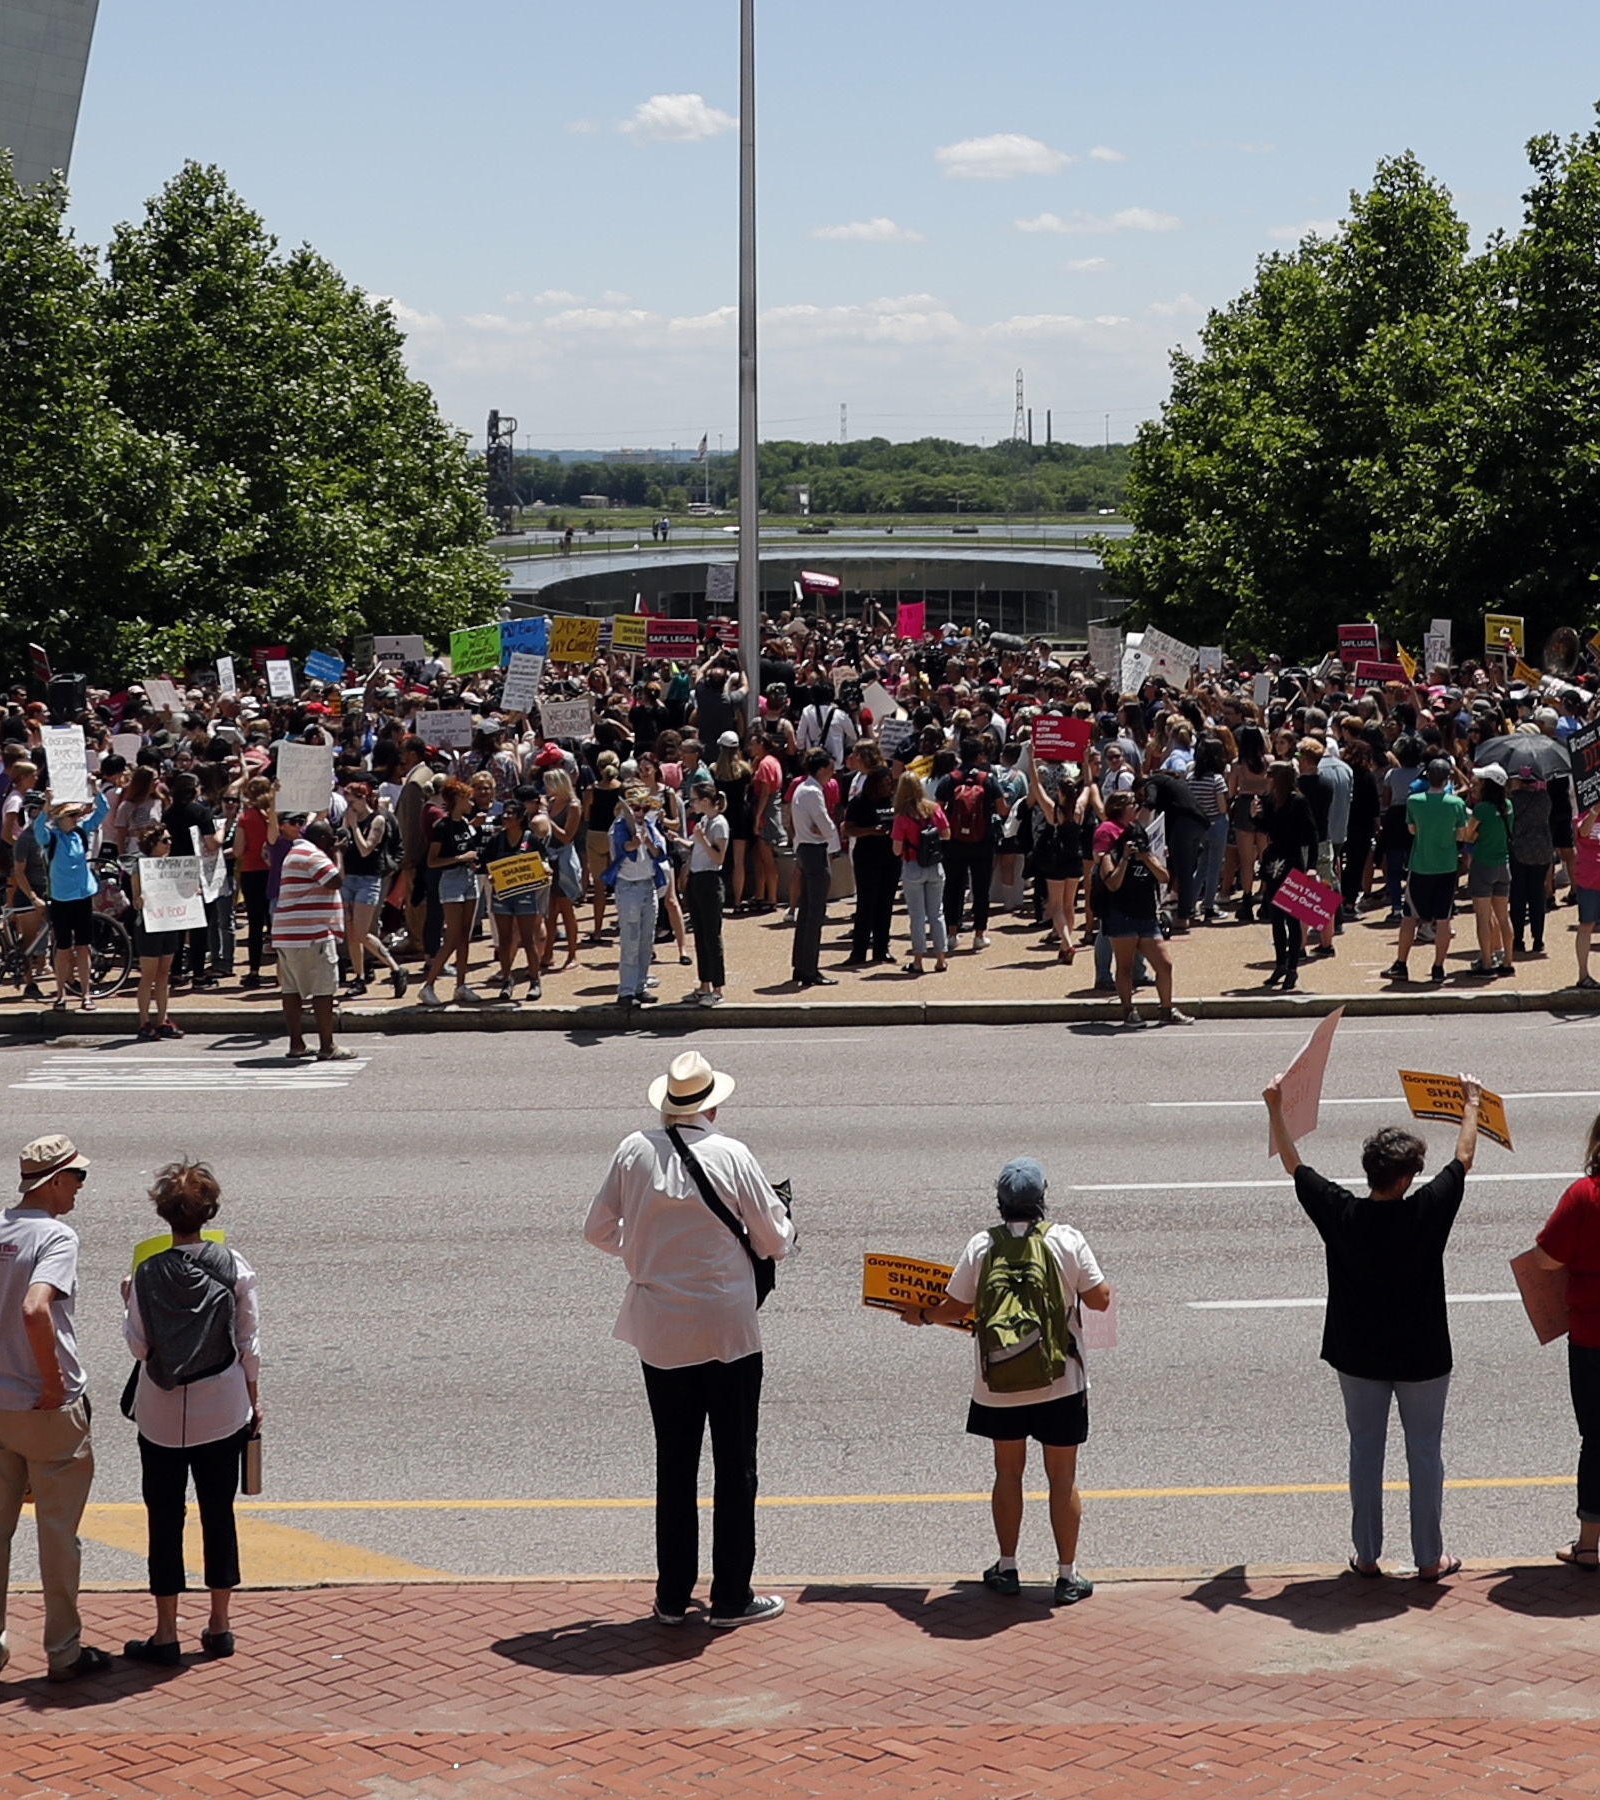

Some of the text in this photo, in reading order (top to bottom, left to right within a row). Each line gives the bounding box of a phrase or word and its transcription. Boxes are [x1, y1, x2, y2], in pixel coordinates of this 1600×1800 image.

[1365, 667, 1402, 677] PROTECT
[1035, 740, 1076, 748] PARENTHOOD
[1569, 730, 1597, 753] Women
[489, 860, 518, 872] Governor
[501, 864, 532, 878] SHAME
[505, 873, 536, 886] on YOU
[1279, 884, 1300, 901] Away
[1298, 896, 1314, 909] Our
[1284, 877, 1322, 903] Don't Take
[1403, 1075, 1461, 1088] Governo
[1426, 1087, 1463, 1101] SHA
[1432, 1101, 1455, 1110] on
[867, 1257, 931, 1275] Governor
[887, 1271, 948, 1296] SHAM
[888, 1286, 912, 1300] on
[915, 1291, 948, 1307] YO
